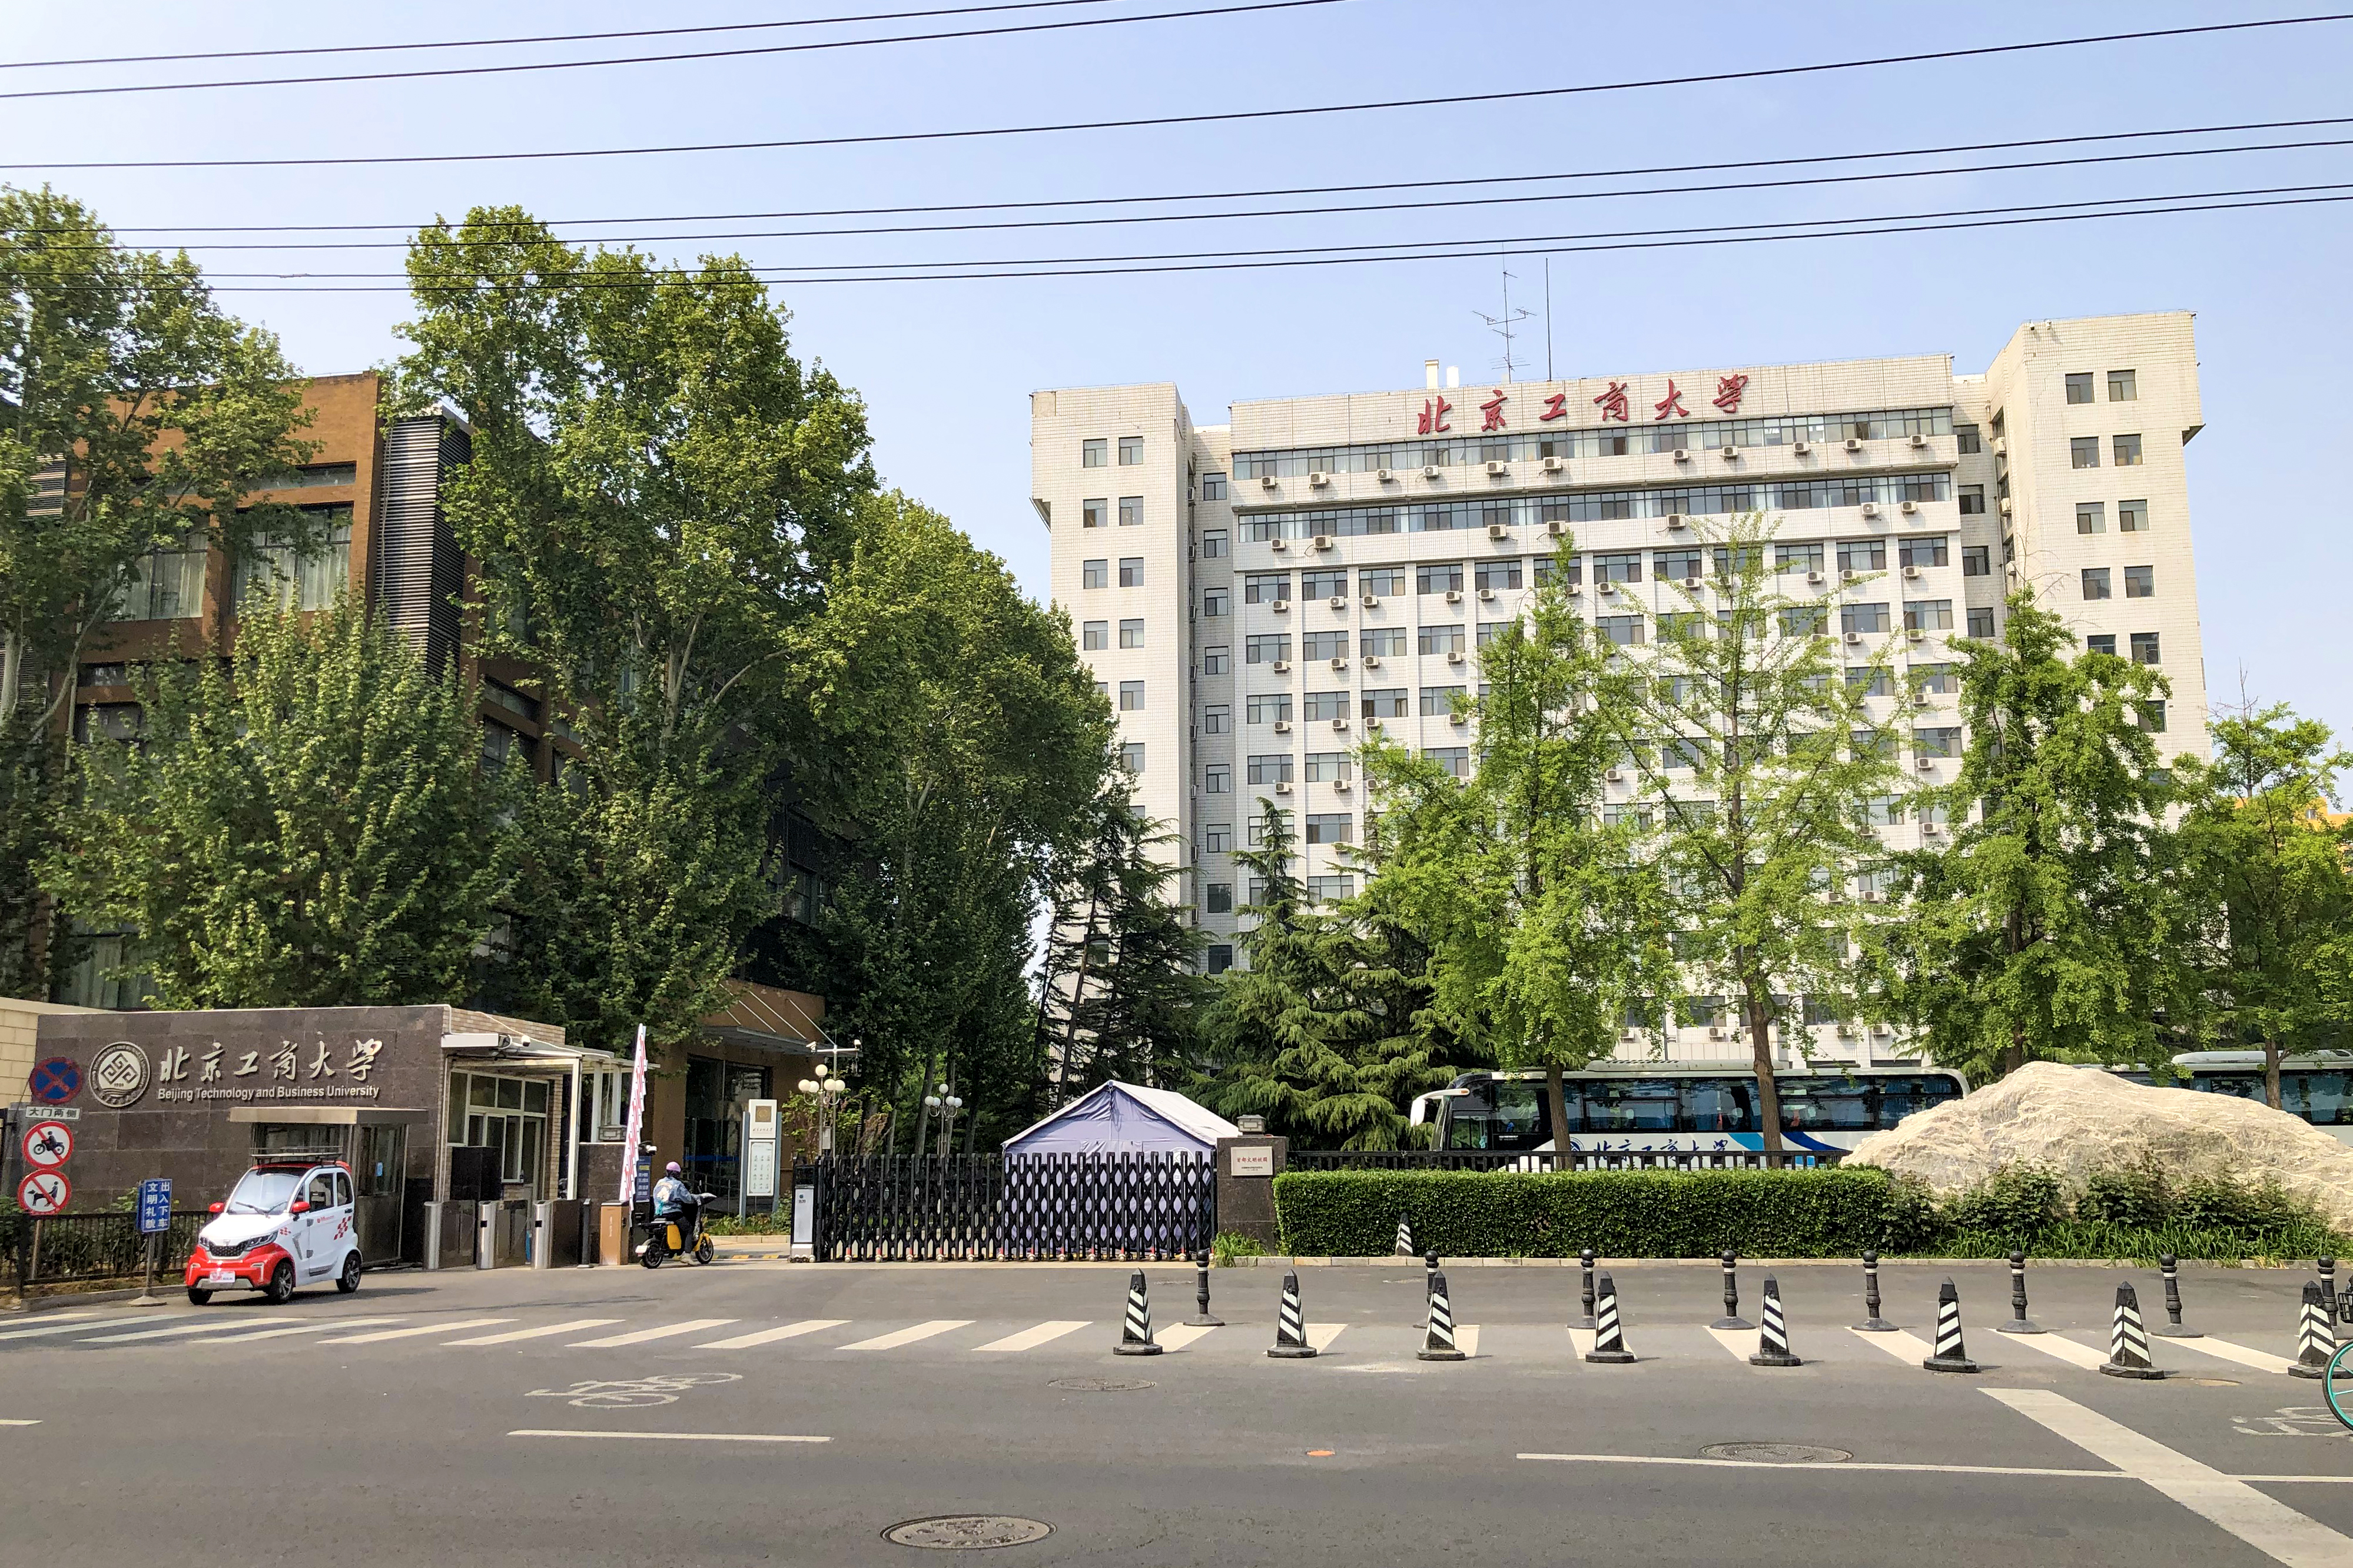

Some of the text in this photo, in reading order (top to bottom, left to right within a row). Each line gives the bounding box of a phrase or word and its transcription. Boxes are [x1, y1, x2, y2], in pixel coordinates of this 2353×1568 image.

[158, 1085, 380, 1101] Beijing Technology and Business University
[29, 1107, 77, 1118] 大门两侧
[145, 1182, 158, 1229] 文明礼貌
[158, 1181, 170, 1228] 出入下车
